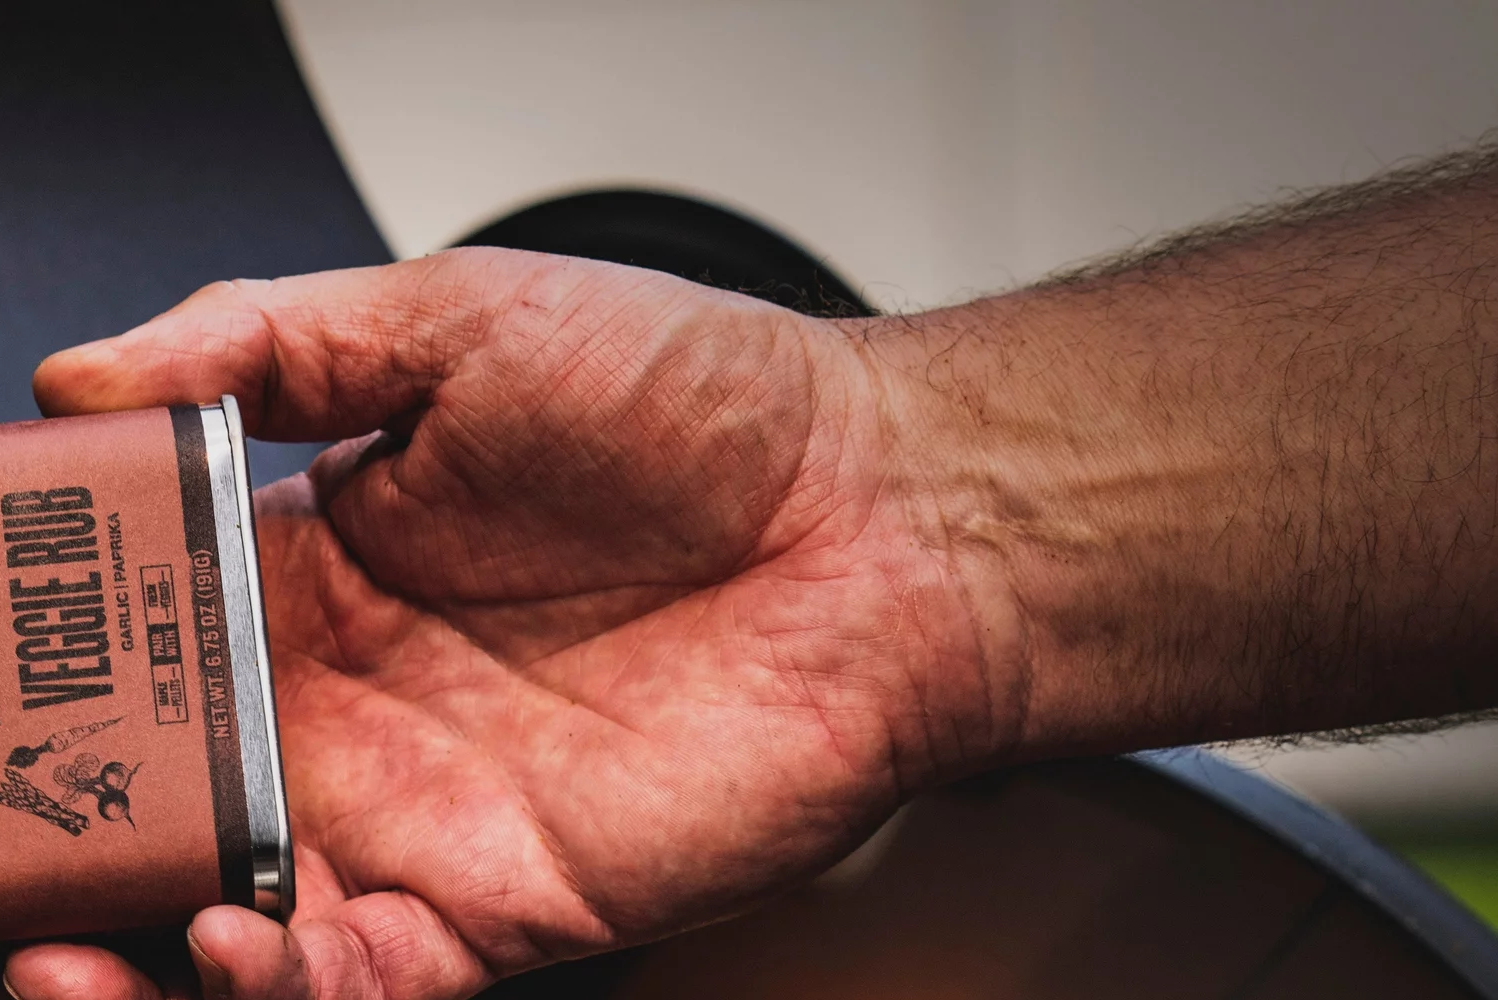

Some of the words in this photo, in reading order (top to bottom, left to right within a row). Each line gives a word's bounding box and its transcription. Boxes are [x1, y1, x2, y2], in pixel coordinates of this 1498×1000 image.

[0, 486, 100, 568] RUB
[107, 512, 127, 582] PAPRIKA
[192, 549, 216, 599] (191G)
[116, 592, 134, 652] GARLIC
[199, 604, 216, 626] OZ
[8, 571, 114, 710] VEGGIE
[152, 633, 165, 656] PAIR
[164, 631, 178, 656] WITH
[201, 631, 222, 667] 6.75
[208, 672, 225, 702] WT.
[210, 706, 230, 739] NET
